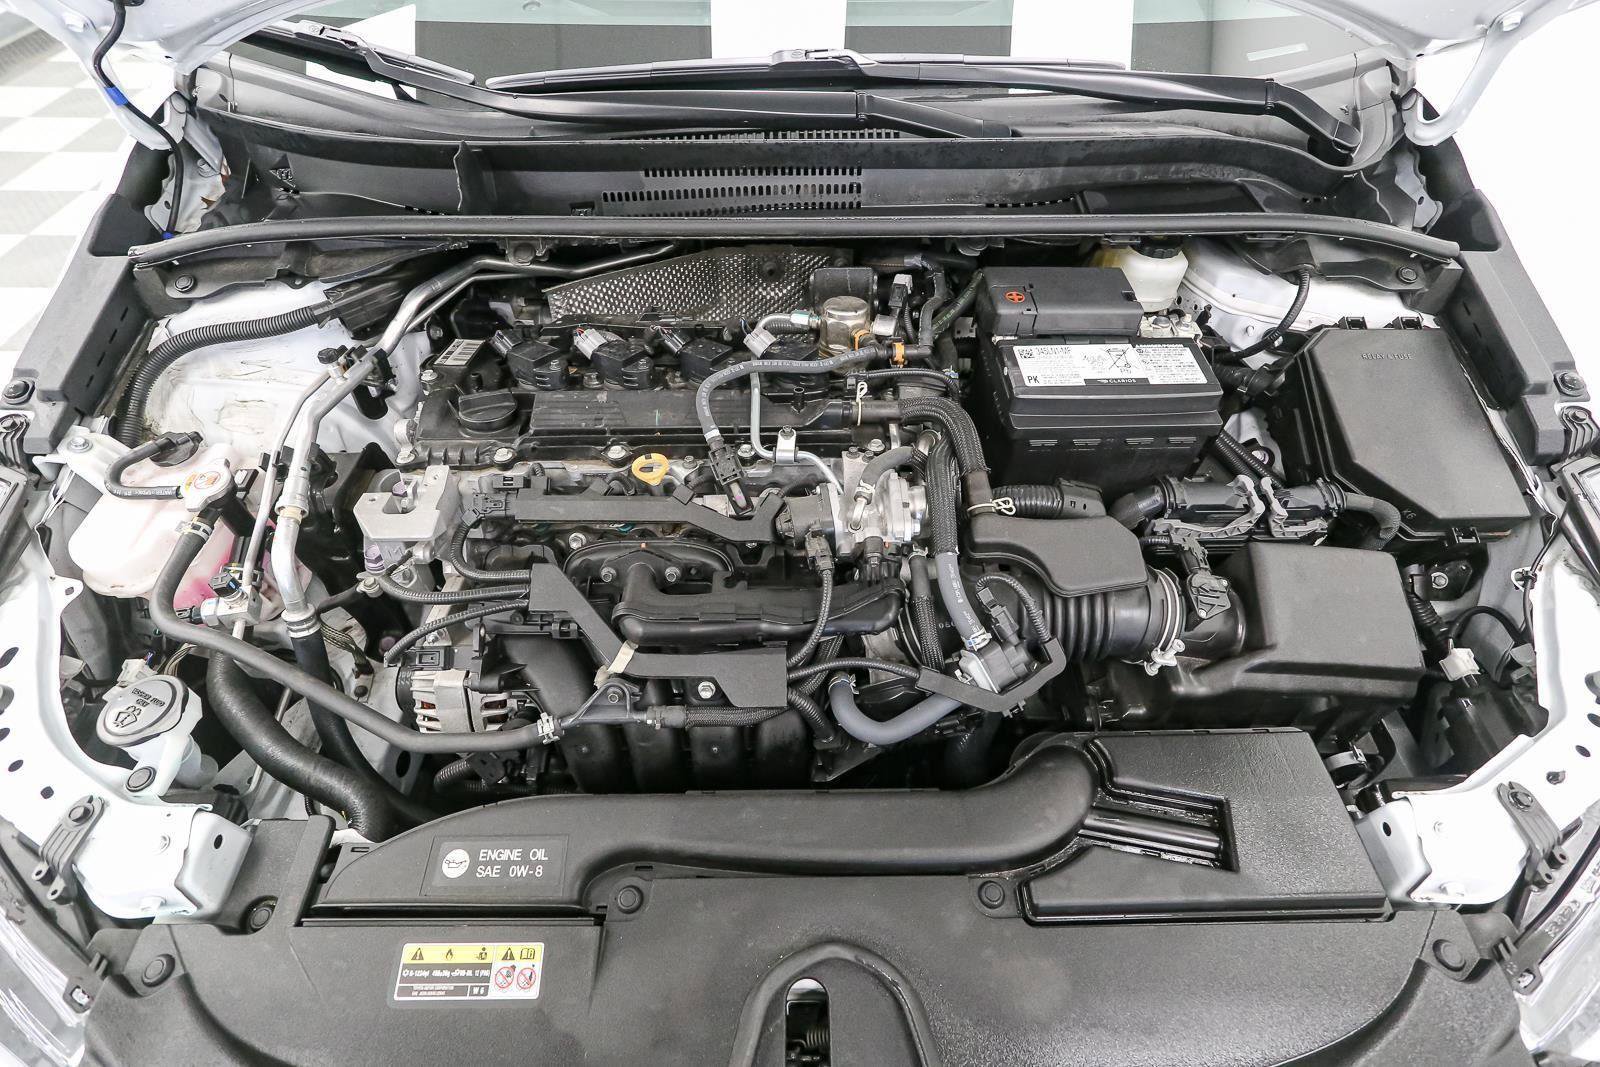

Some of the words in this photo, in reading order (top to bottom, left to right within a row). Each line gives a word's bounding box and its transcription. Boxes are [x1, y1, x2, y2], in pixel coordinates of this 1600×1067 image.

[1027, 375, 1040, 384] PK
[479, 848, 523, 861] ENGINE
[529, 848, 549, 861] OIL
[476, 865, 501, 878] SAE
[509, 865, 543, 878] 0W-8
